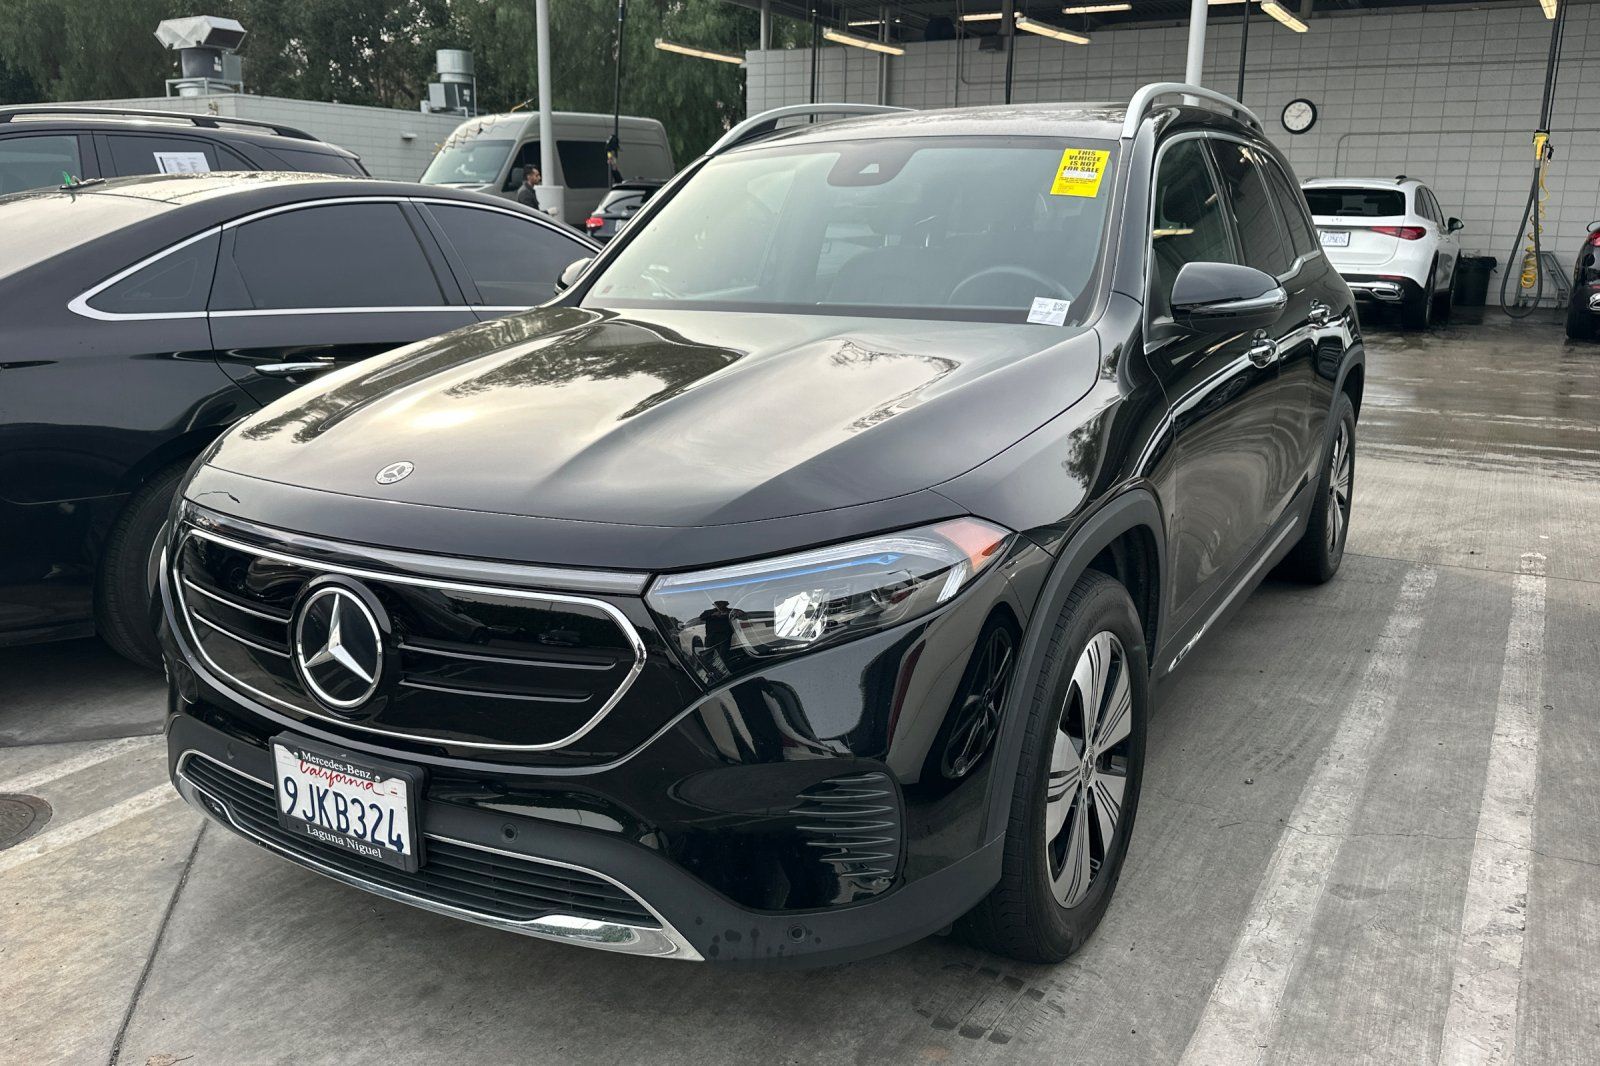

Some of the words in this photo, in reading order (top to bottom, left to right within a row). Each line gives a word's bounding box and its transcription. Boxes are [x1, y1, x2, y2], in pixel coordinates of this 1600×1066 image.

[299, 759, 385, 797] California
[301, 750, 372, 780] Mercedes-Benz
[284, 776, 404, 853] 9JKB324
[306, 823, 345, 848] Laguna
[346, 838, 383, 859] Niguel
